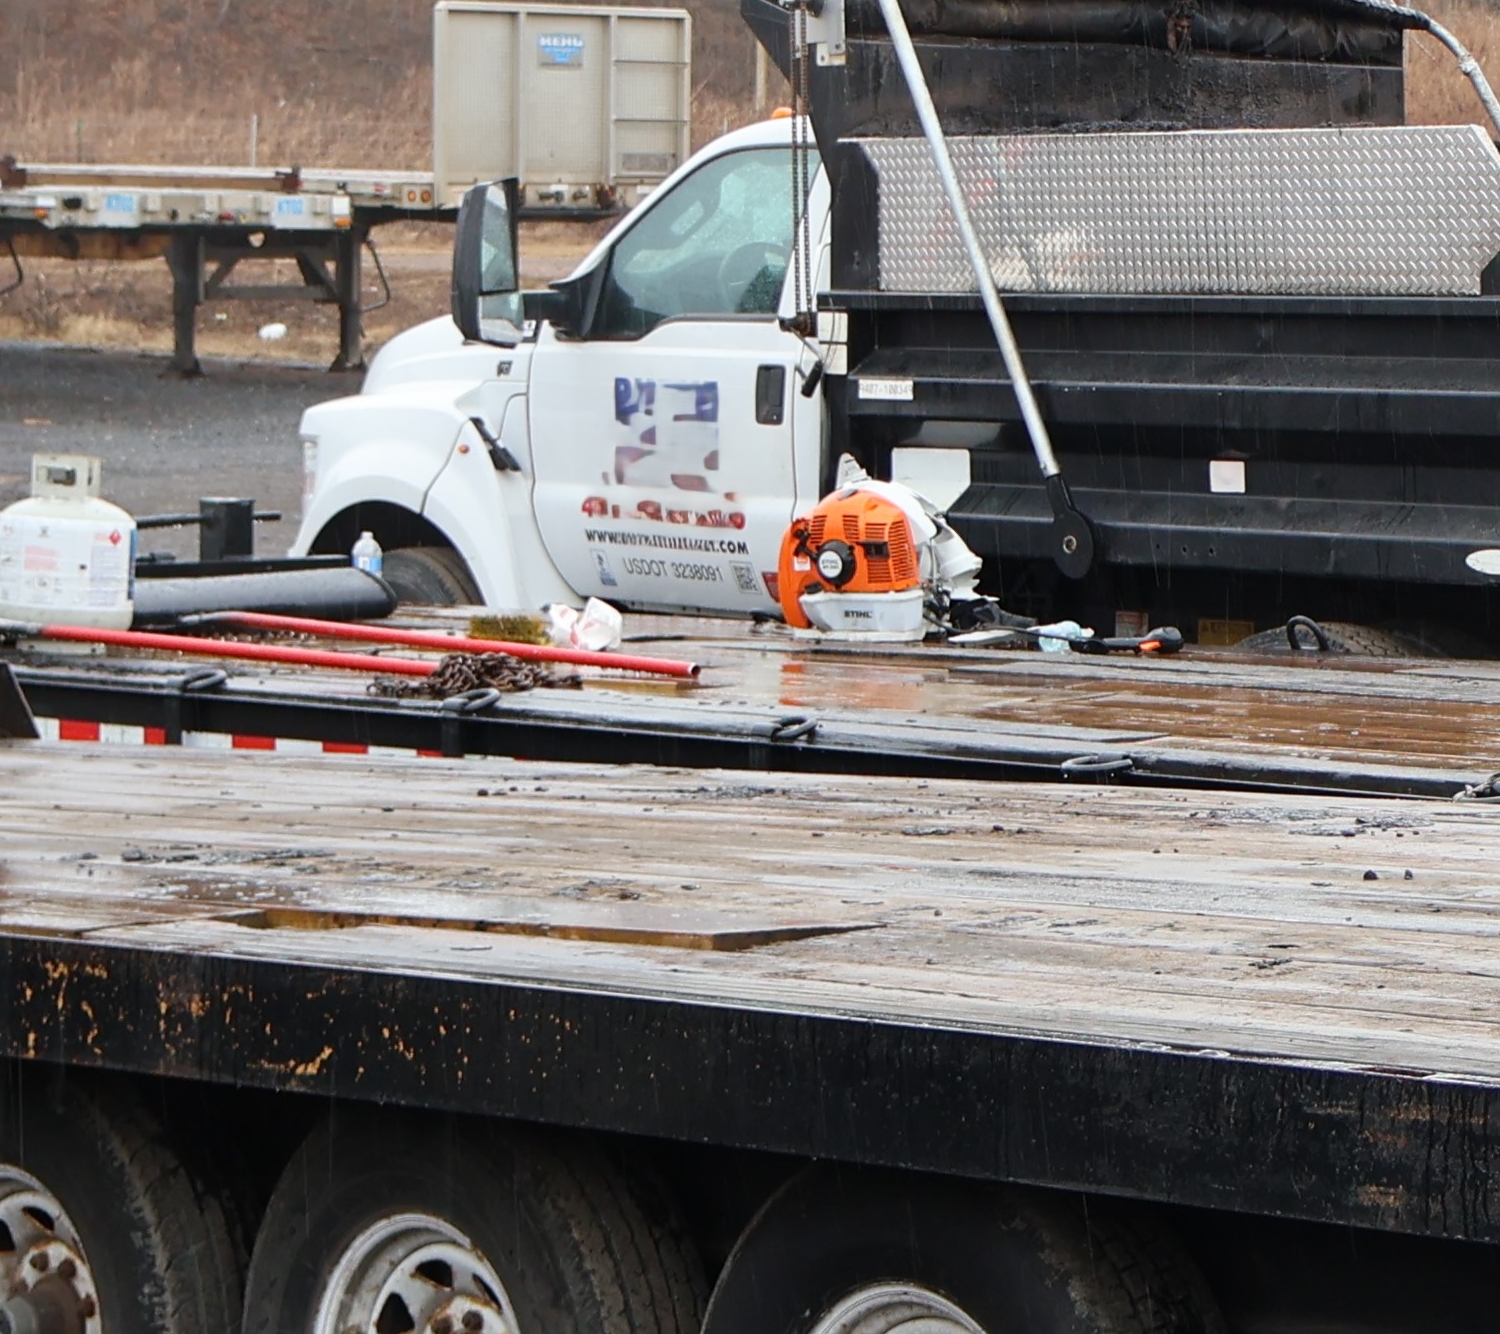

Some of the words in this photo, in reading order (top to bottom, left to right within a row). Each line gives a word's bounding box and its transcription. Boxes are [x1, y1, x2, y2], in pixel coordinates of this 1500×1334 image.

[623, 557, 668, 578] USDOT
[671, 562, 723, 582] 3238091
[844, 610, 872, 619] STIHL
